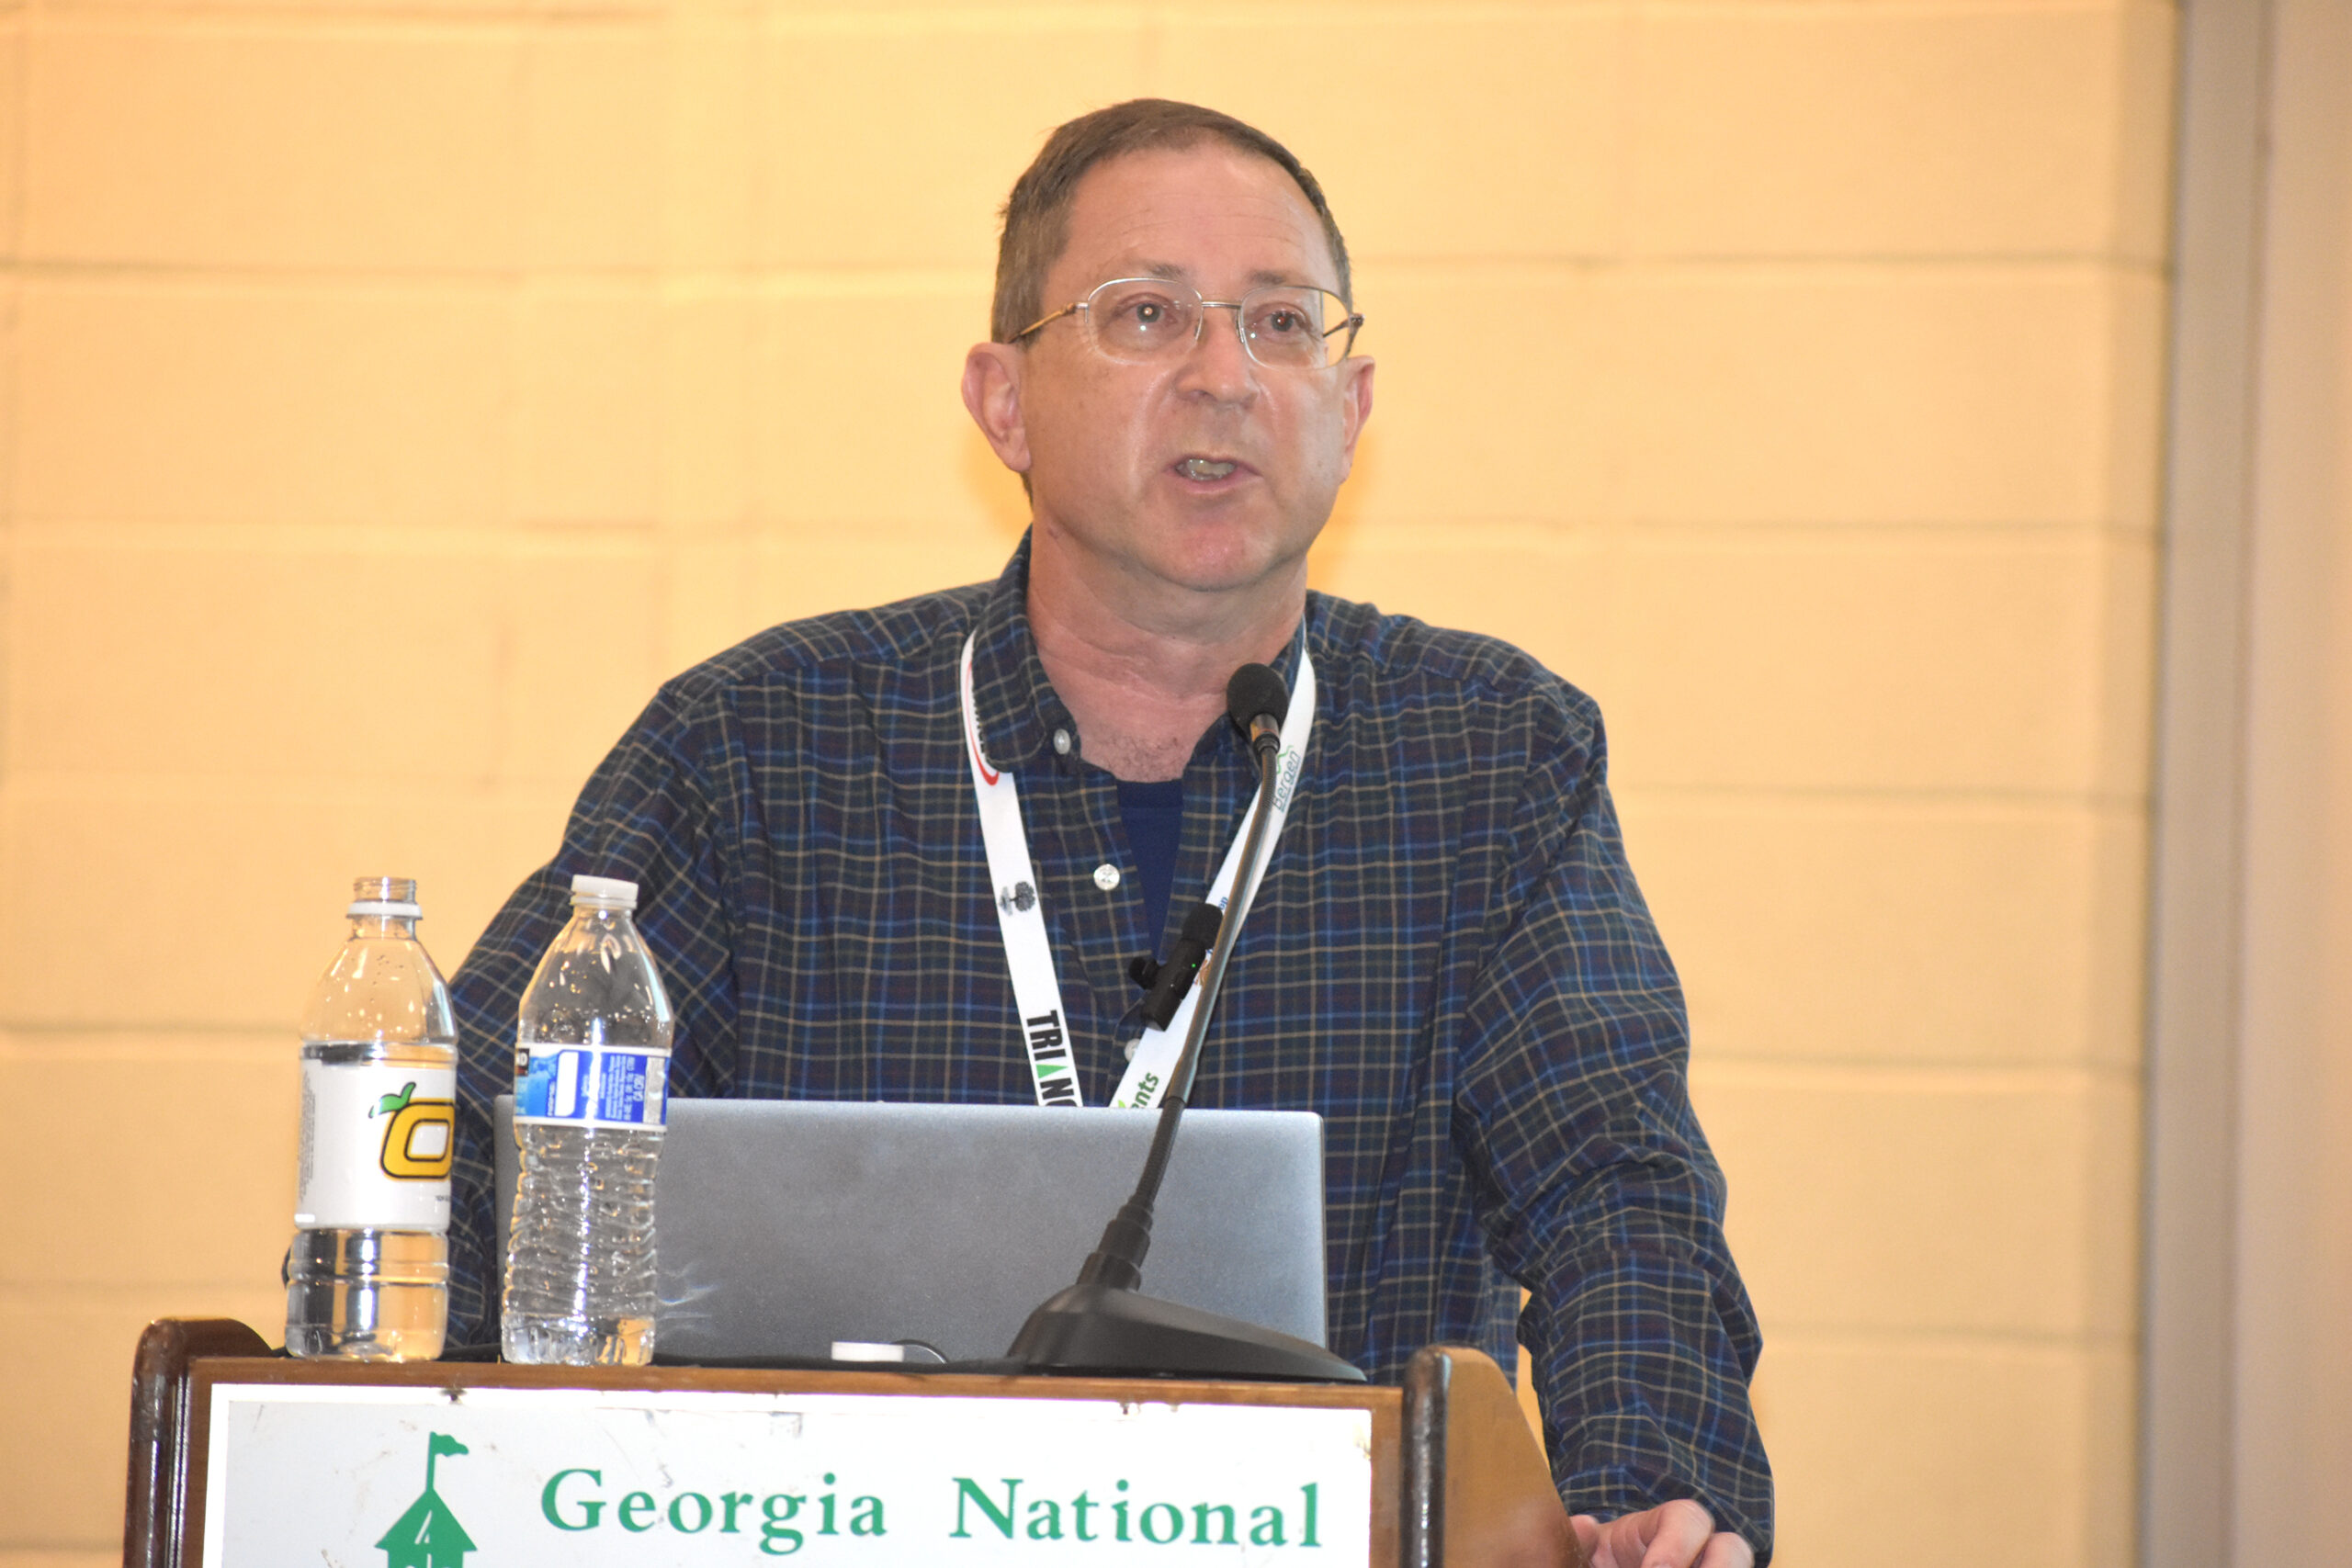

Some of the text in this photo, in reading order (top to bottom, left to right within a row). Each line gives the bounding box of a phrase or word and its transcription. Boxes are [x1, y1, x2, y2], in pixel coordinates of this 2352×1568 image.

[1272, 750, 1301, 811] Bergen
[1026, 1009, 1078, 1106] TRIAN
[541, 1468, 1322, 1556] Georgia National
